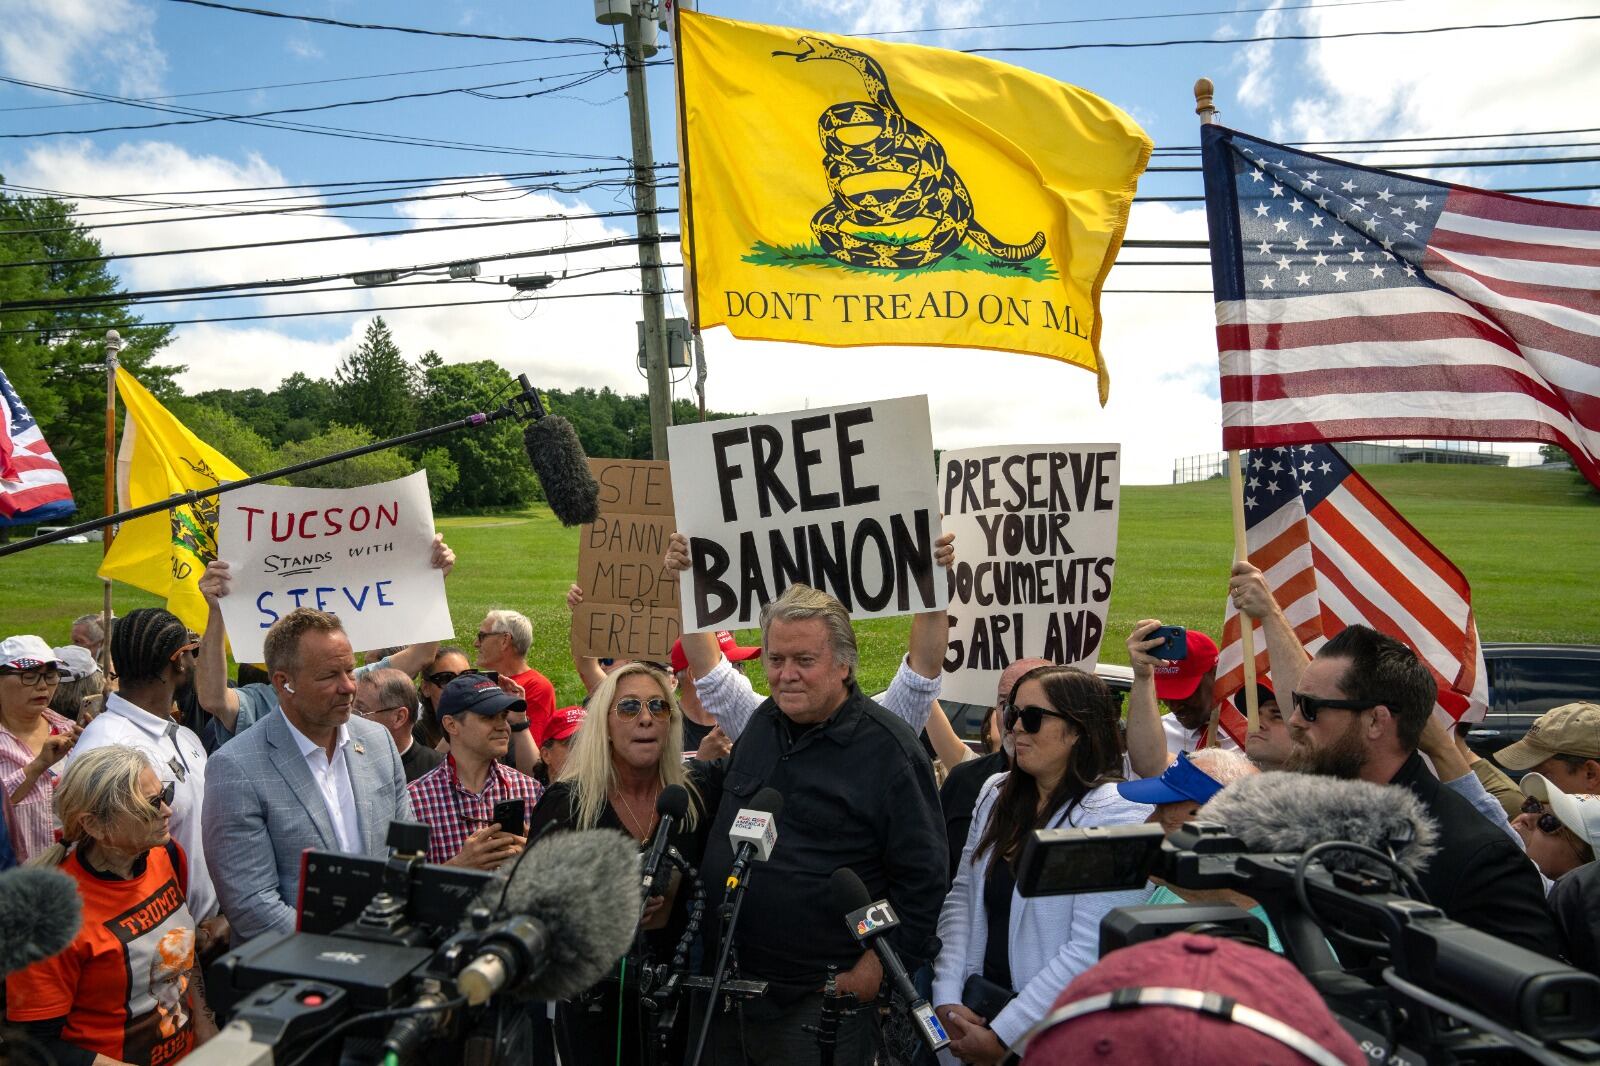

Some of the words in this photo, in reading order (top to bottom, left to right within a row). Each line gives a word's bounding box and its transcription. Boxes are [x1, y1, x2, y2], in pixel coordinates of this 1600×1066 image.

[725, 290, 821, 321] DONT
[833, 290, 968, 323] TREAD
[978, 294, 1030, 326] ON
[599, 465, 665, 506] STE
[712, 407, 881, 522] FREE
[944, 451, 1117, 516] PRESERVE
[236, 501, 399, 543] TUCSON
[590, 517, 671, 556] BANN
[975, 513, 1075, 556] YOUR
[264, 551, 333, 574] STANDS
[348, 542, 394, 558] WITH
[690, 508, 937, 629] BANNON
[591, 561, 676, 601] MEDA
[256, 580, 395, 629] STEVE
[630, 598, 661, 615] OF
[588, 612, 680, 656] FREED
[119, 885, 180, 936] TRUMP
[865, 902, 894, 926] CT
